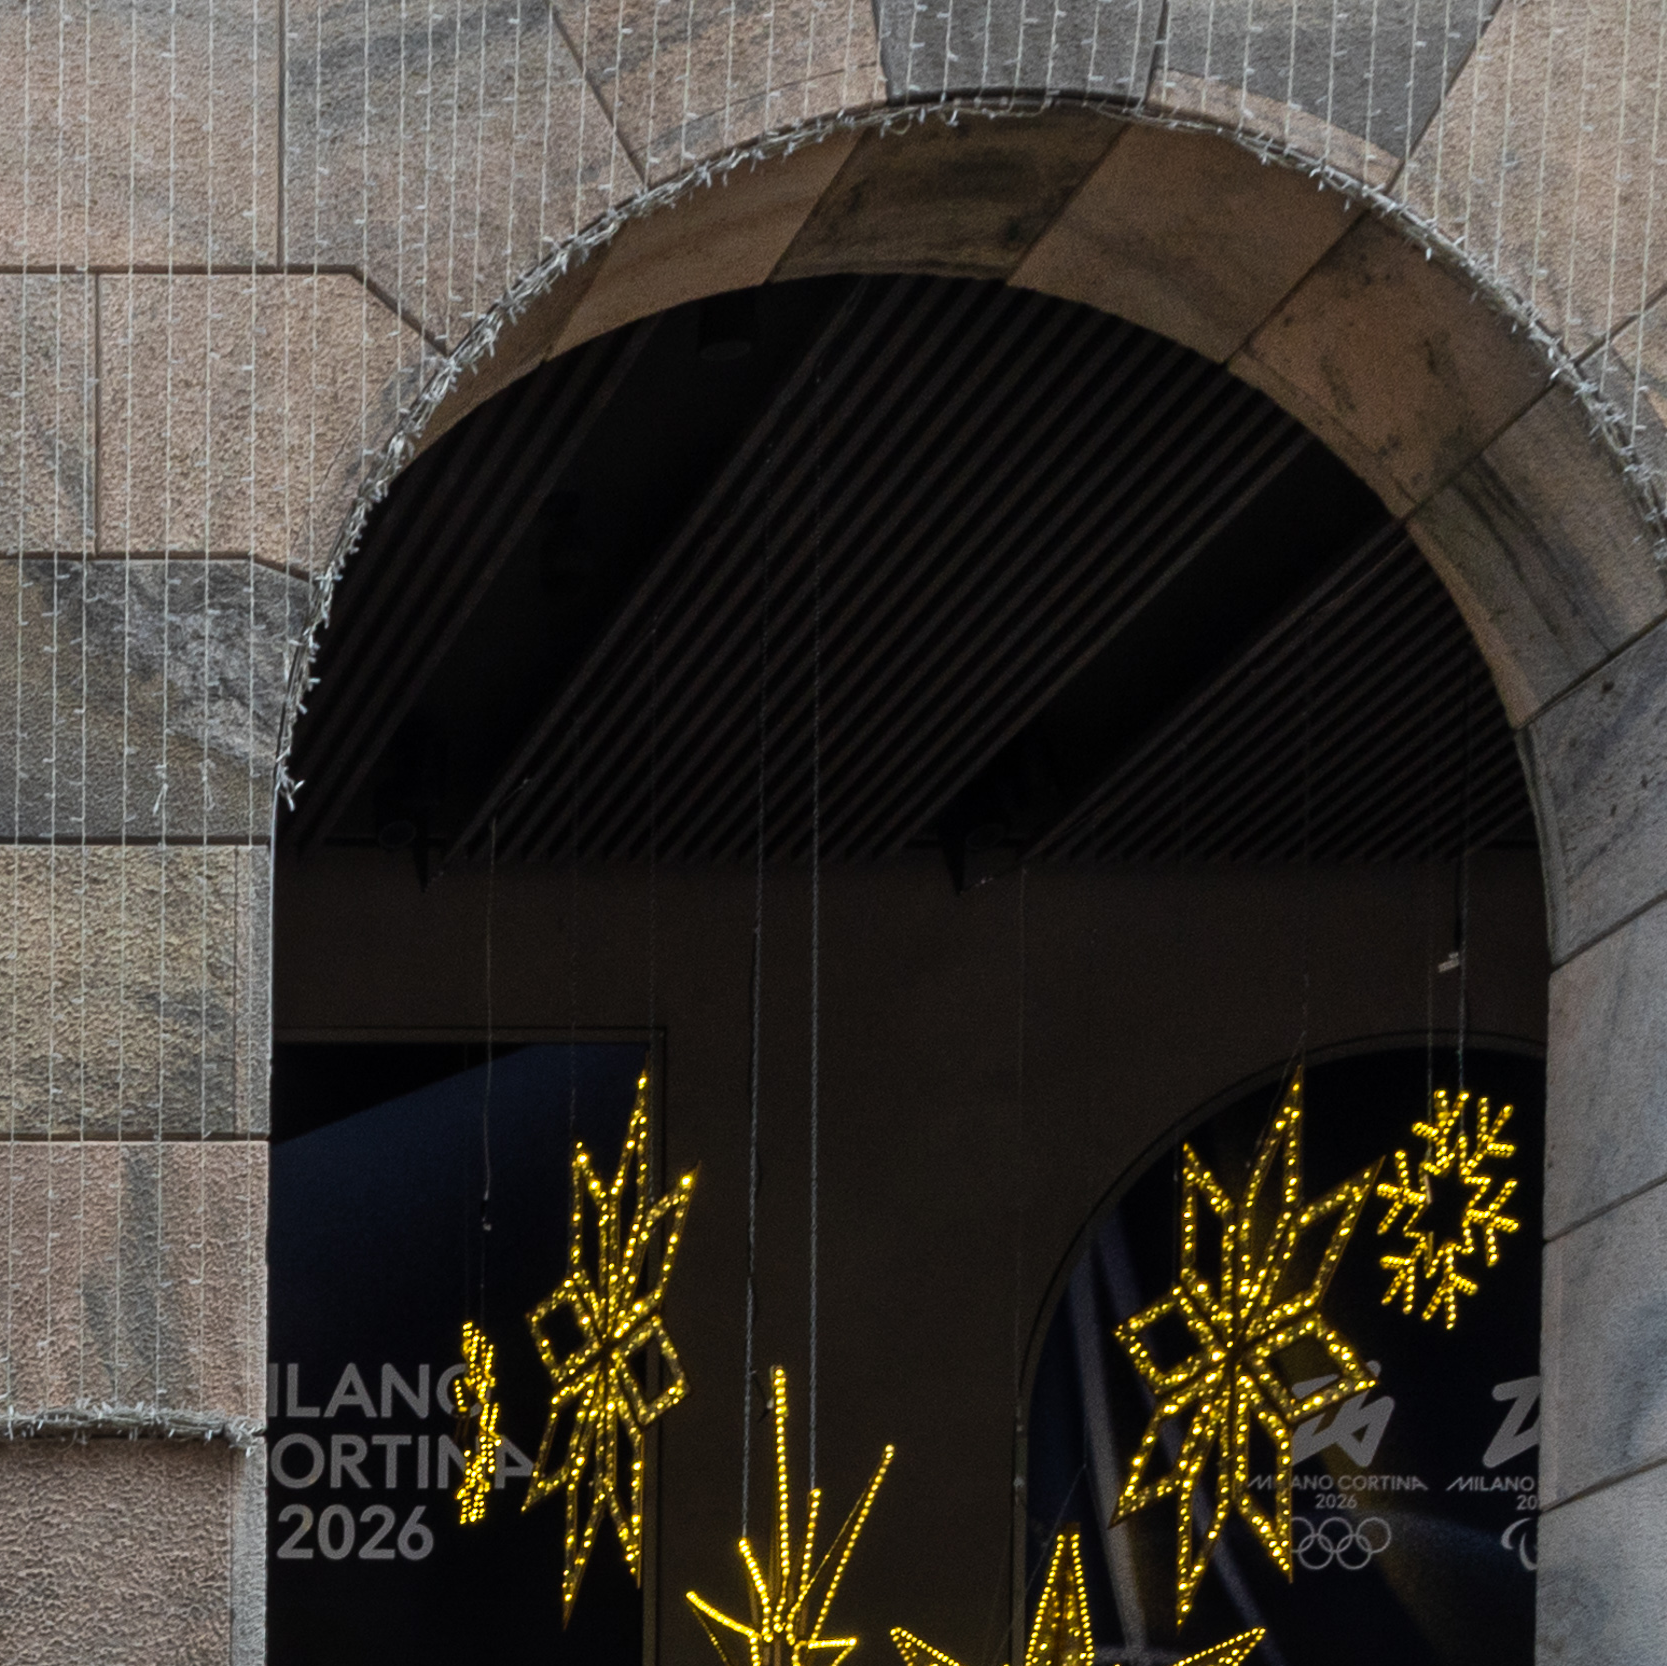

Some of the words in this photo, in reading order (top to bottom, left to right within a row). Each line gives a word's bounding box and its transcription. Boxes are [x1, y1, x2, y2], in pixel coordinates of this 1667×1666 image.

[267, 1362, 492, 1419] ILANO
[269, 1433, 536, 1490] ORTINA
[1314, 1492, 1358, 1510] 2026
[1337, 1474, 1429, 1491] CORTINA
[1446, 1475, 1535, 1492] MILANO
[276, 1503, 435, 1560] 2026
